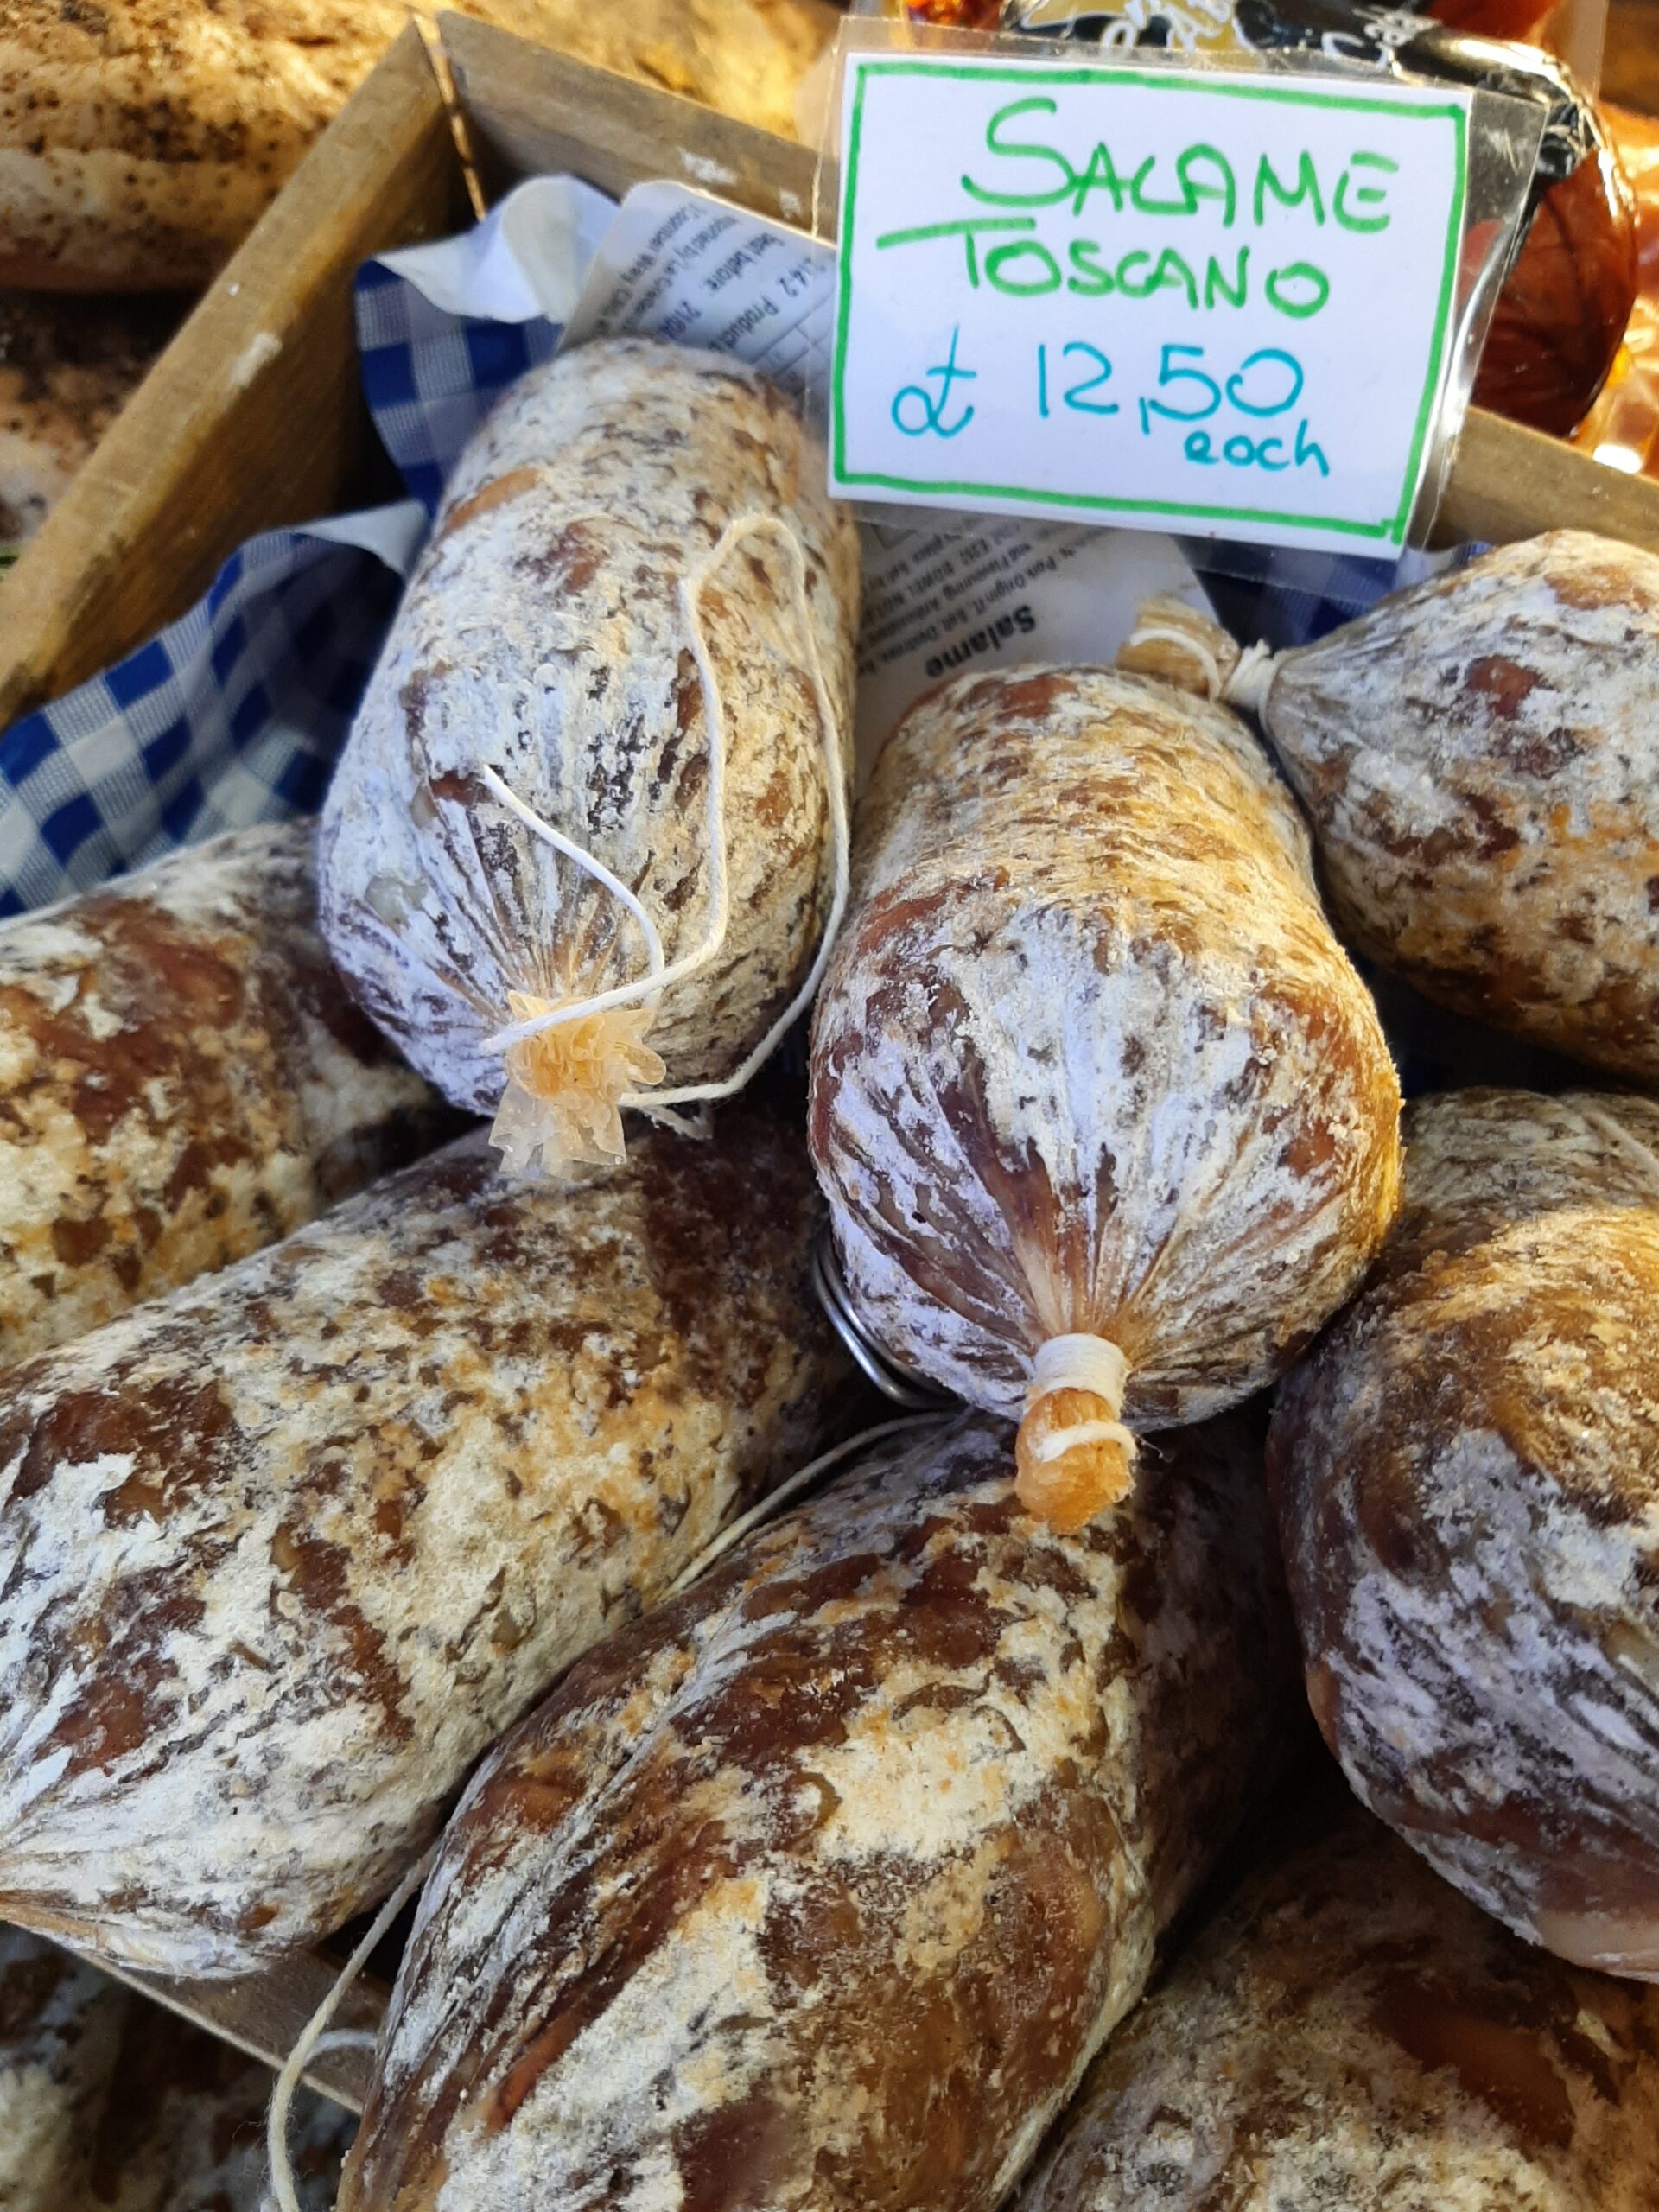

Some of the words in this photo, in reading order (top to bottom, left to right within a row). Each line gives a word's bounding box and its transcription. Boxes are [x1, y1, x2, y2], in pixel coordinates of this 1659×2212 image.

[876, 218, 1331, 318] TOSCANO
[1037, 342, 1304, 435] 12,50
[925, 603, 1038, 679] Salame
